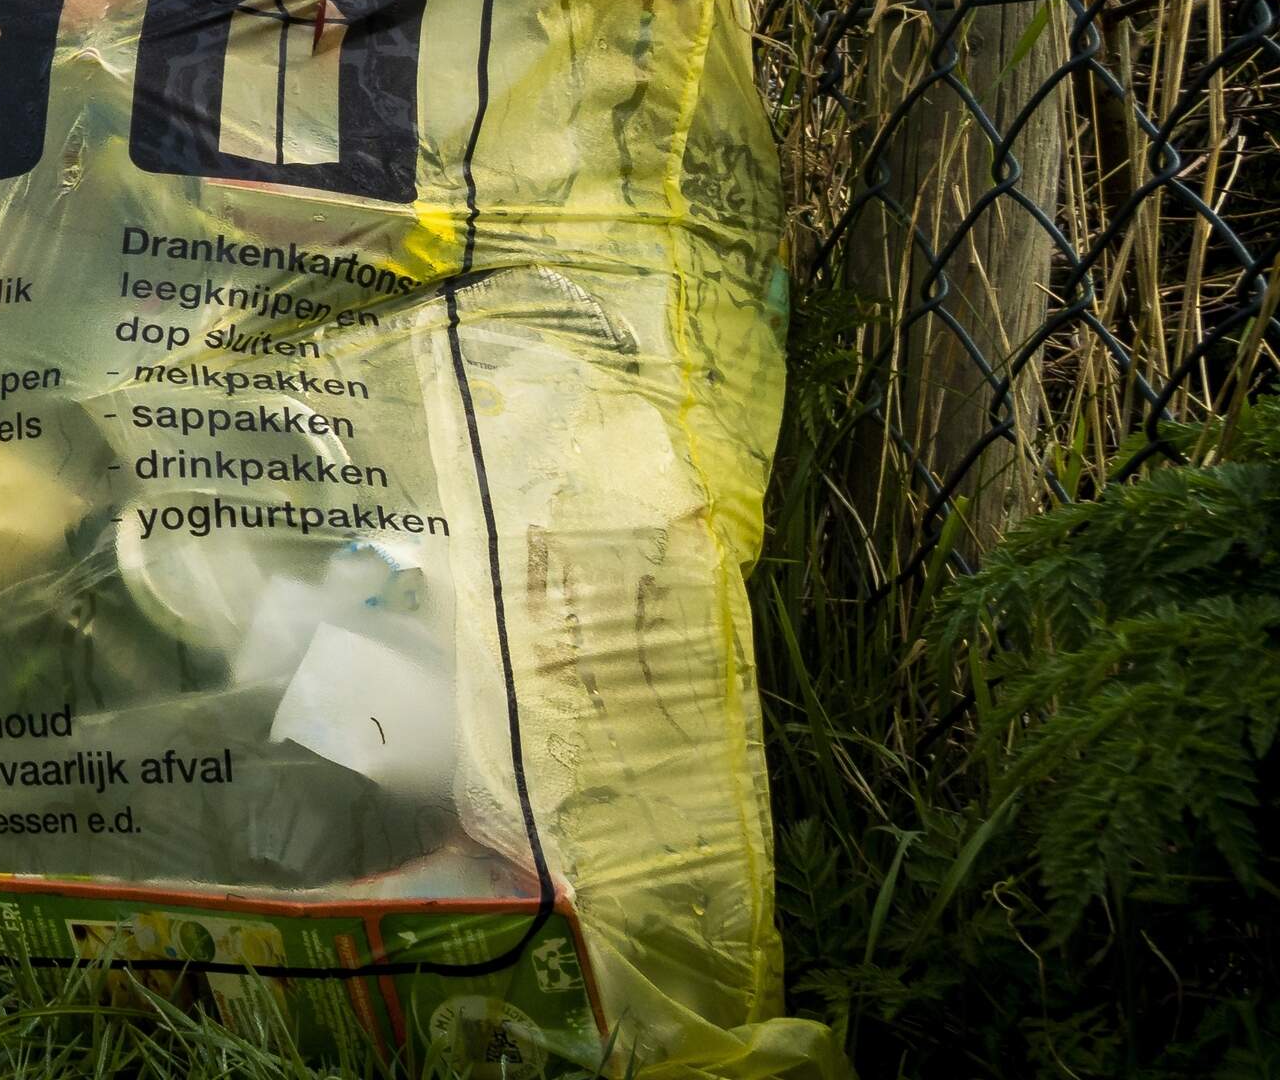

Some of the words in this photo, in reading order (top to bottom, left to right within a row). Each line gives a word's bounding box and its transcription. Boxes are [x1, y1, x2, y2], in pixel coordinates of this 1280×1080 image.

[120, 272, 332, 322] leegknijpen
[335, 309, 380, 328] en
[115, 316, 191, 350] dop
[205, 323, 321, 359] sluiten
[134, 362, 370, 400] melkpakken
[132, 404, 354, 439] sappakken
[135, 449, 388, 488] drinkpakken
[136, 497, 451, 540] yoghurtpakken
[140, 748, 233, 784] afval
[87, 805, 142, 835] e.d.
